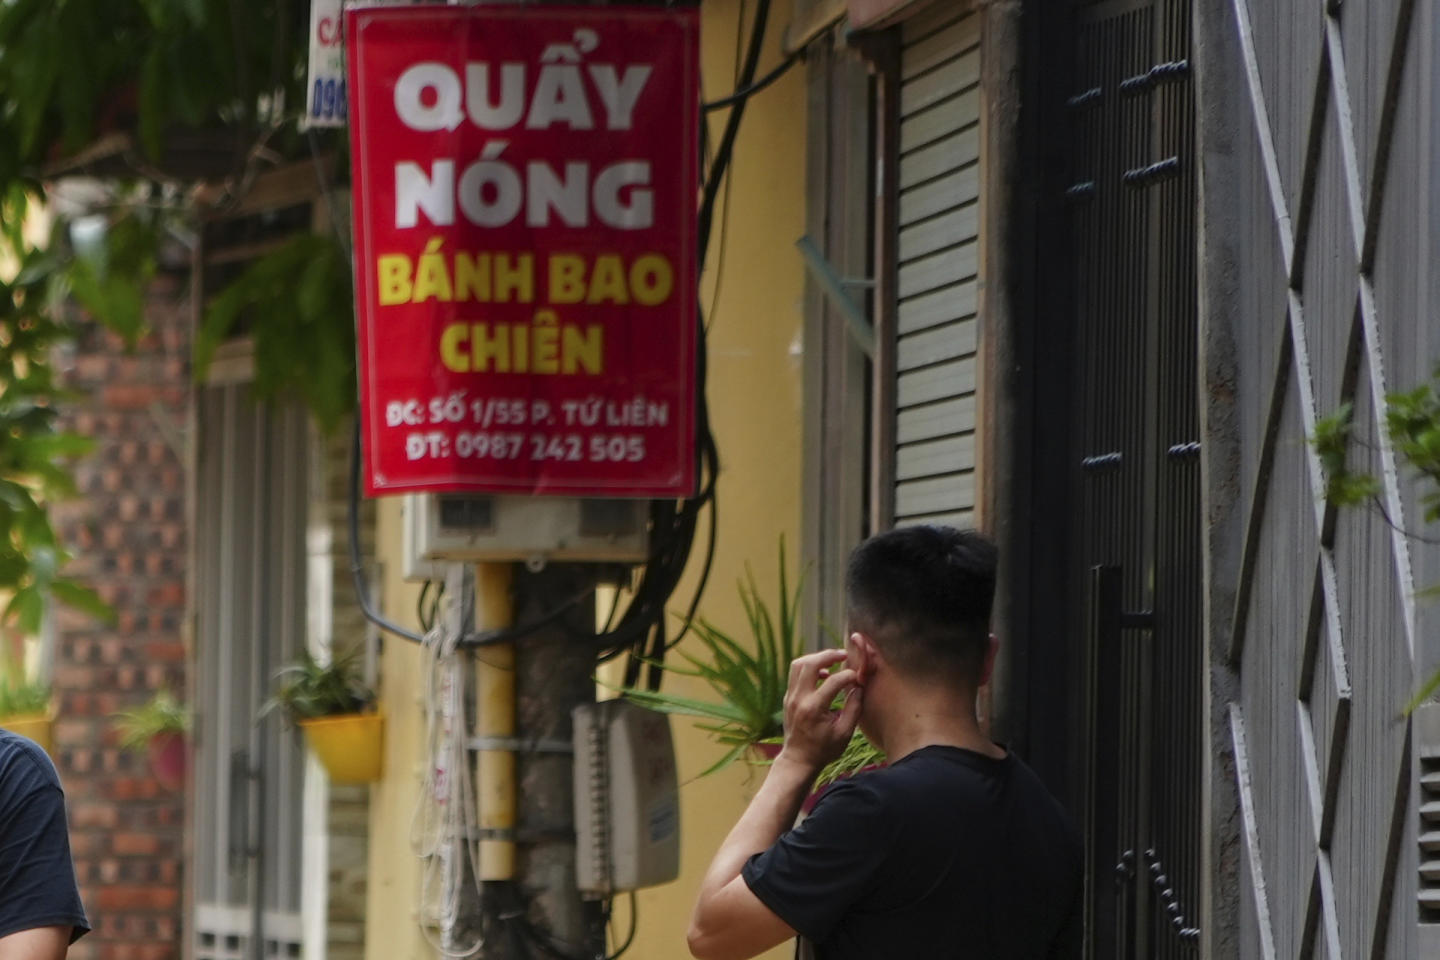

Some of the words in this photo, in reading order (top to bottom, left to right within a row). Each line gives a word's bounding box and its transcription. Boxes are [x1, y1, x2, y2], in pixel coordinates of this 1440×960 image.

[394, 28, 653, 132] QUẨY
[394, 139, 654, 229] NÓNG
[377, 237, 534, 305] BÁNH
[548, 254, 673, 305] BAO
[440, 309, 603, 374] CHIÊN
[428, 390, 467, 423] SỐ
[470, 399, 526, 428] 1/55
[532, 400, 555, 425] P.
[606, 395, 668, 427] LIÊN
[406, 433, 449, 460] ĐT:
[455, 432, 522, 459] 0987
[531, 435, 582, 461] 242
[589, 436, 645, 461] 505
